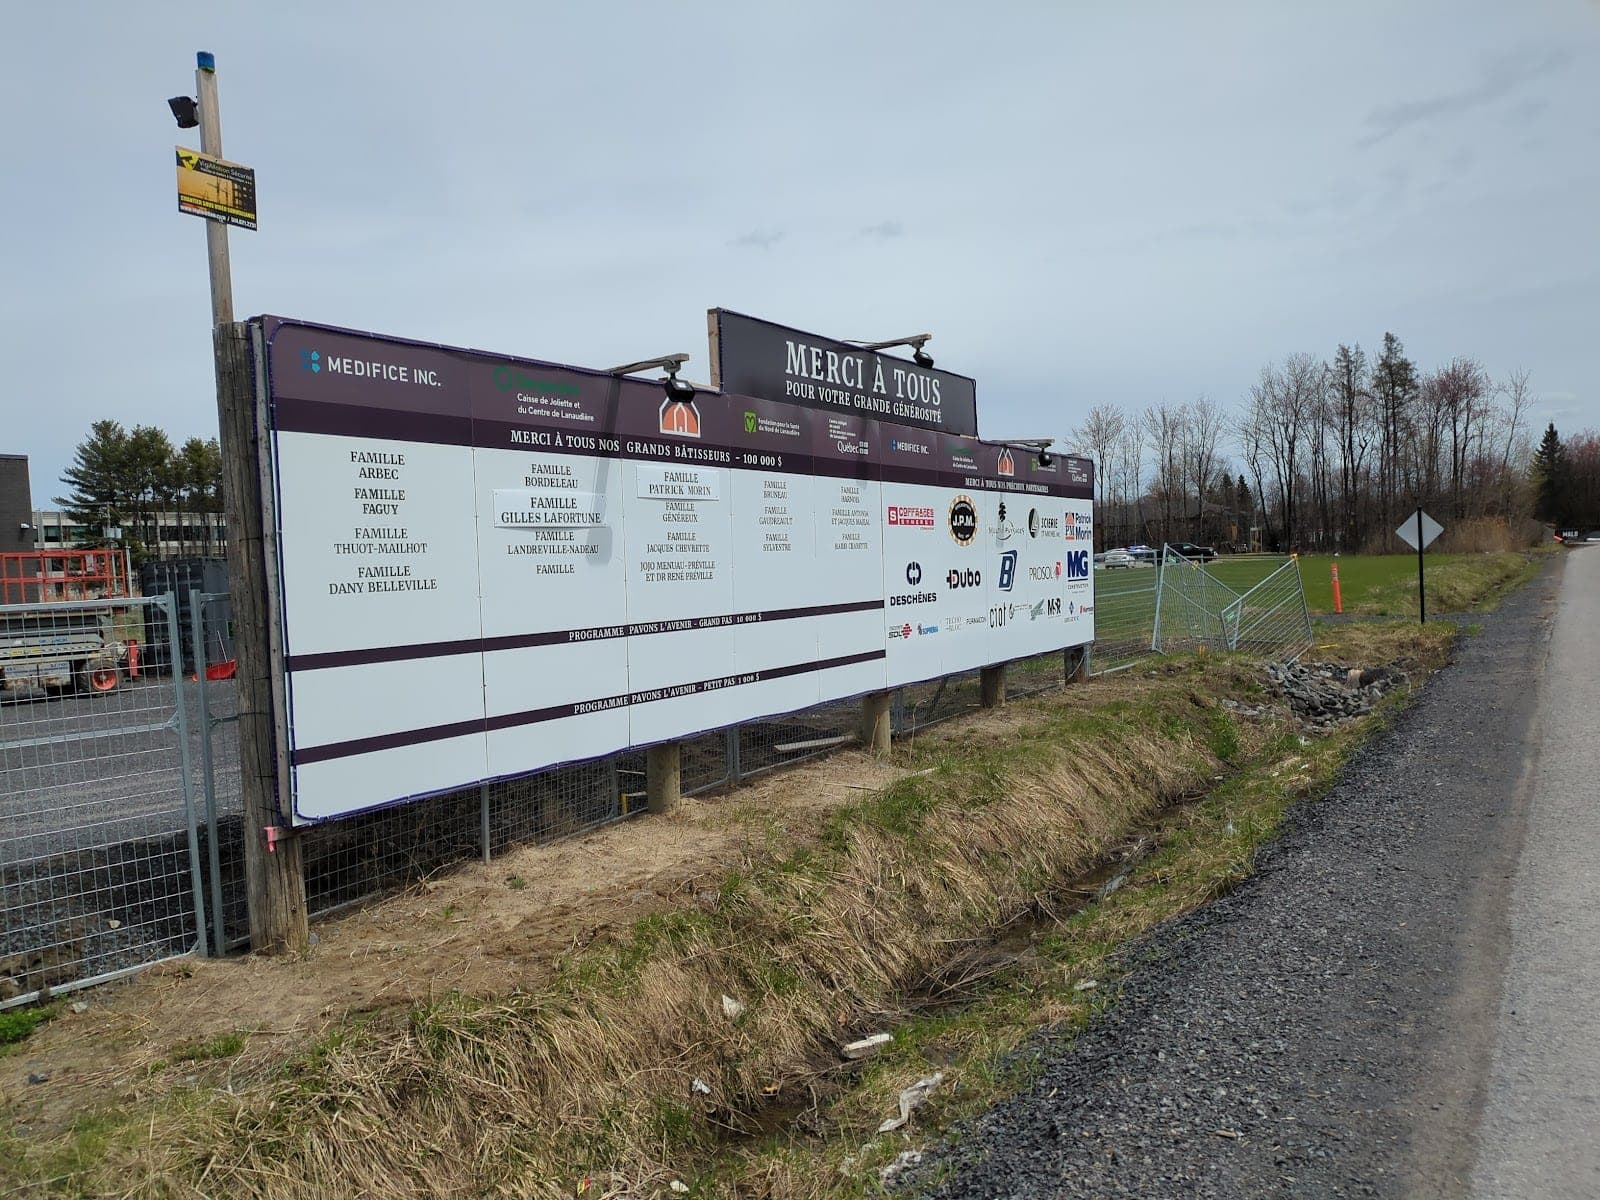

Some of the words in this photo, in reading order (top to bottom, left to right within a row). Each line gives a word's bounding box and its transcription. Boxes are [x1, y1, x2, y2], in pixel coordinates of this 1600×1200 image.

[327, 356, 408, 382] MEDIFICE
[414, 368, 441, 387] INC.
[785, 341, 863, 389] MERCI
[873, 356, 887, 394] À
[894, 368, 941, 406] TOUS
[517, 393, 538, 404] Caisse
[540, 396, 548, 405] de
[550, 398, 573, 409] Joliette
[573, 401, 580, 409] et
[786, 381, 815, 400] POUR
[818, 387, 850, 406] VOTRE
[854, 394, 891, 414] GRANDE
[893, 401, 942, 423] GÉNÉROSITÉ
[518, 405, 527, 414] du
[528, 406, 550, 417] Centre
[551, 409, 560, 418] de
[561, 410, 594, 422] Lanaudière
[510, 430, 551, 446] MERCI
[555, 431, 563, 447] À
[566, 435, 595, 449] TOUS
[598, 439, 620, 452] NOS
[626, 441, 670, 456] GRANDS
[675, 444, 730, 462] BÂTISSEURS
[743, 454, 758, 465] 100
[760, 455, 776, 466] 000
[777, 455, 783, 467] $
[837, 440, 859, 454] Québec
[897, 441, 920, 454] MEDIFICE
[350, 451, 405, 465] FAMILLE
[359, 467, 399, 480] ARBEC
[531, 464, 572, 476] FAMILLE
[525, 476, 578, 488] BORDELEAU
[664, 472, 698, 483] FAMILLE
[649, 484, 684, 495] PATRICK
[688, 486, 711, 496] MORIN
[764, 481, 787, 490] FAMILLE
[841, 486, 859, 495] FAMILLE
[354, 488, 405, 501] FAMILLE
[763, 491, 787, 499] BRUNEAU
[363, 503, 399, 515] FAGUY
[530, 497, 577, 509] FAMILLE
[666, 502, 694, 511] FAMILLE
[663, 512, 698, 522] GÉNÉREUX
[765, 507, 787, 515] FAMILLE
[890, 510, 897, 520] S
[501, 511, 541, 523] GILLES
[544, 512, 601, 524] LAFORTUNE
[952, 515, 975, 527] J.P.M.
[1041, 518, 1058, 529] SCIERIE
[1076, 512, 1091, 524] Patrick
[355, 528, 408, 539] FAMILLE
[535, 531, 575, 541] FAMILLE
[667, 532, 696, 541] FAMILLE
[765, 534, 788, 542] FAMILLE
[1076, 526, 1092, 540] Morin
[334, 543, 428, 554] THUOT-MAILHOT
[508, 544, 599, 554] LANDREVILLE-NADEAU
[647, 544, 673, 554] JACQUES
[675, 544, 710, 553] CHEVRETTE
[763, 543, 791, 552] SYLVESTRE
[536, 564, 575, 574] FAMILLE
[640, 561, 655, 571] JOJO
[1067, 550, 1088, 577] MG
[358, 566, 411, 578] FAMILLE
[646, 573, 655, 582] ET
[656, 572, 666, 581] DR
[667, 571, 684, 581] RENÉ
[685, 570, 713, 580] PRÉVILLE
[1029, 566, 1053, 580] PROSOL
[949, 568, 981, 589] Dubo
[329, 582, 364, 594] DANY
[368, 579, 437, 593] BELLEVILLE
[890, 591, 937, 606] DESCHÊNES
[569, 626, 624, 641] PROGRAMME
[629, 623, 658, 635] PAVONS
[660, 619, 692, 632] L'AVENIR
[699, 617, 720, 627] GRAND
[721, 616, 733, 625] PAS
[737, 615, 744, 624] 10
[744, 614, 757, 623] 000
[758, 613, 762, 622] $
[574, 697, 629, 715] PROGRAMME
[631, 691, 662, 704] PAVONS
[663, 685, 697, 699] L'AVENIR
[704, 679, 722, 691] PETIT
[723, 677, 735, 687] PAS
[738, 676, 742, 685] 1
[756, 673, 760, 682] $
